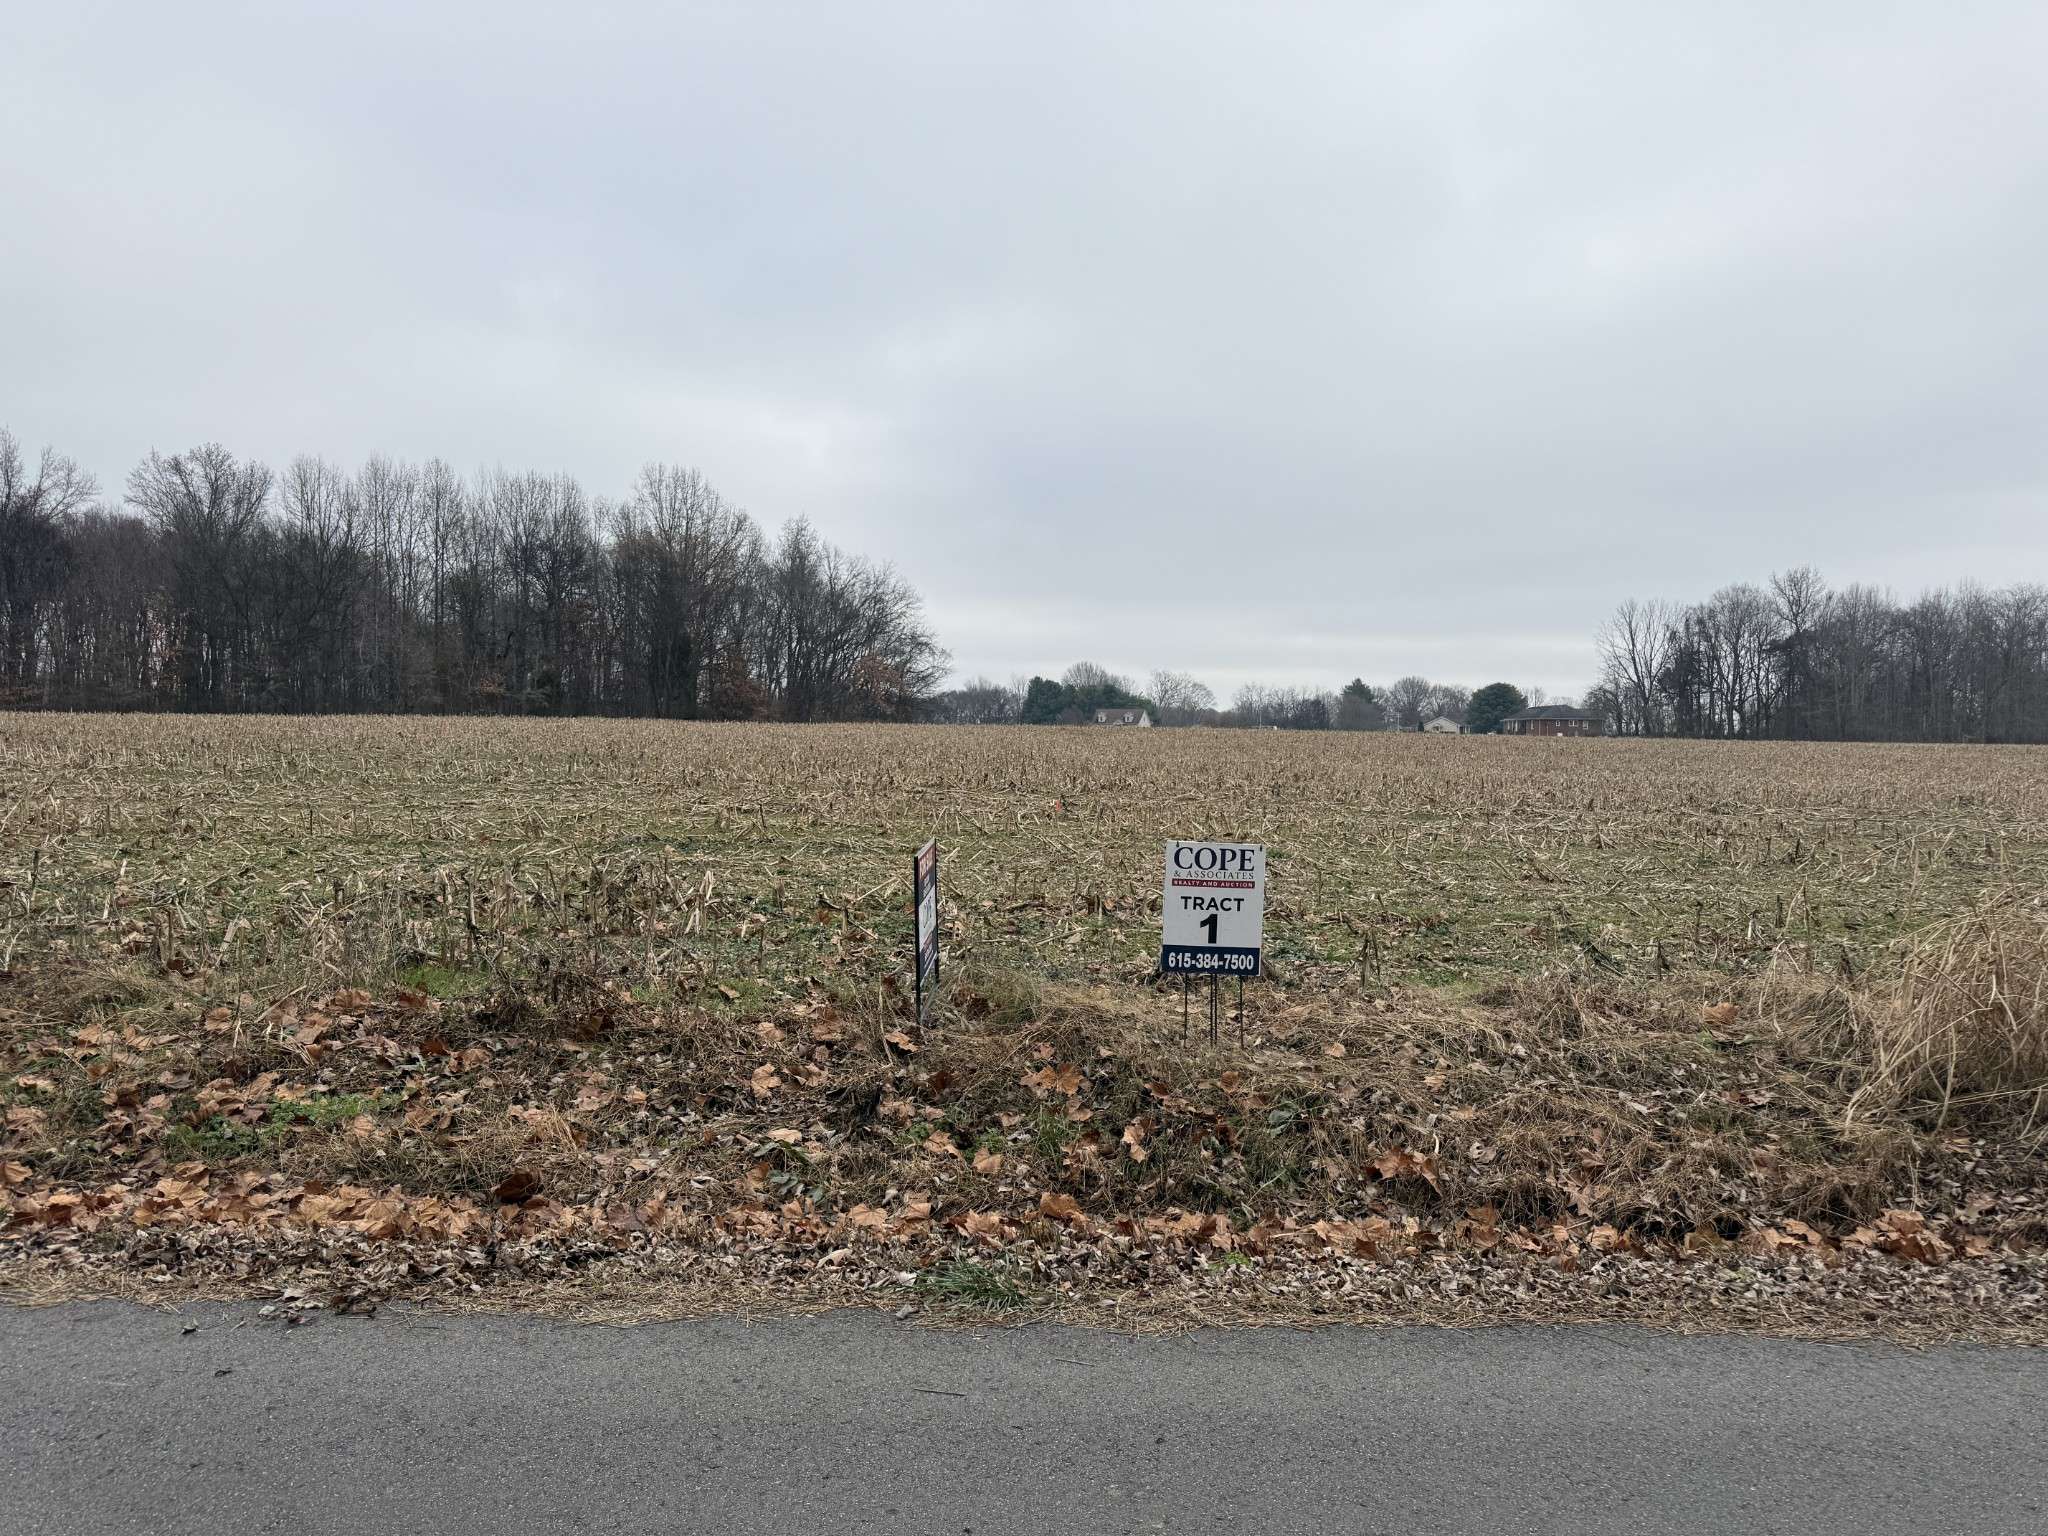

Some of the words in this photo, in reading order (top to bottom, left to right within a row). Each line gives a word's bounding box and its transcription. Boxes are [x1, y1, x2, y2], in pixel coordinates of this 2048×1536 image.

[1174, 847, 1255, 871] COPE
[1186, 870, 1254, 880] ASSOCIATES
[1180, 896, 1244, 912] TRACT
[1199, 913, 1218, 944] 1
[1168, 952, 1254, 970] 615-384-7500
